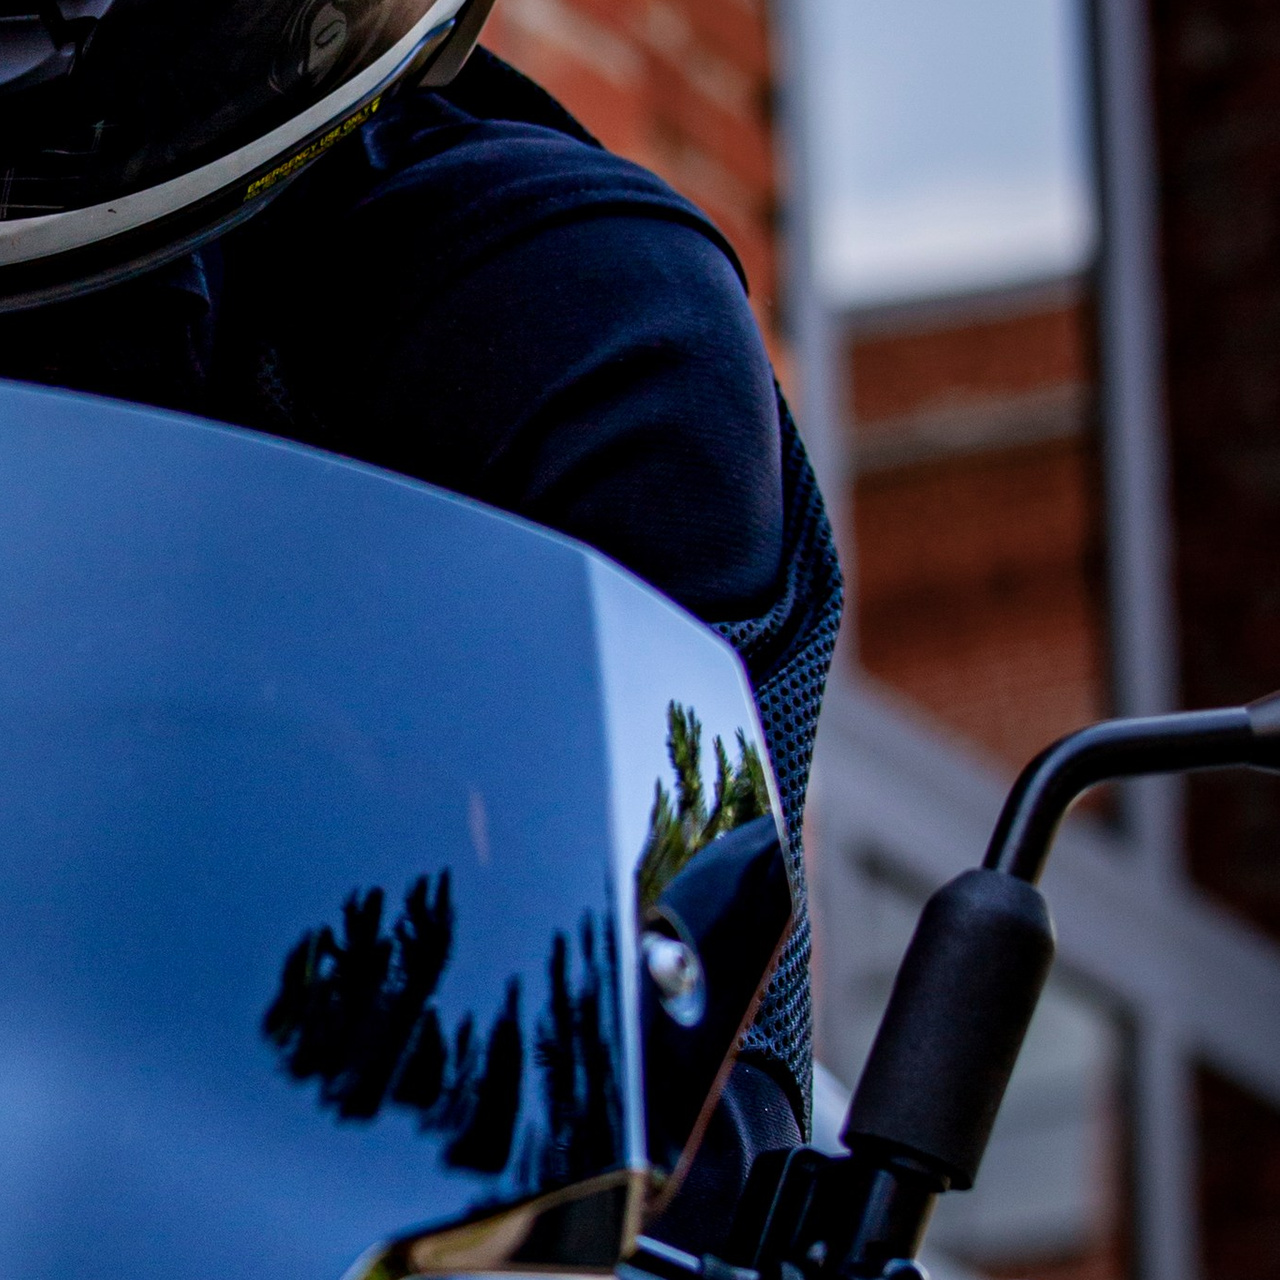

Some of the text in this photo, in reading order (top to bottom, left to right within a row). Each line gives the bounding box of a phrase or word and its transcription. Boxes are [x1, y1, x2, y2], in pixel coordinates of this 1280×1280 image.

[246, 105, 371, 195] EMERGENCY USE ONLY
